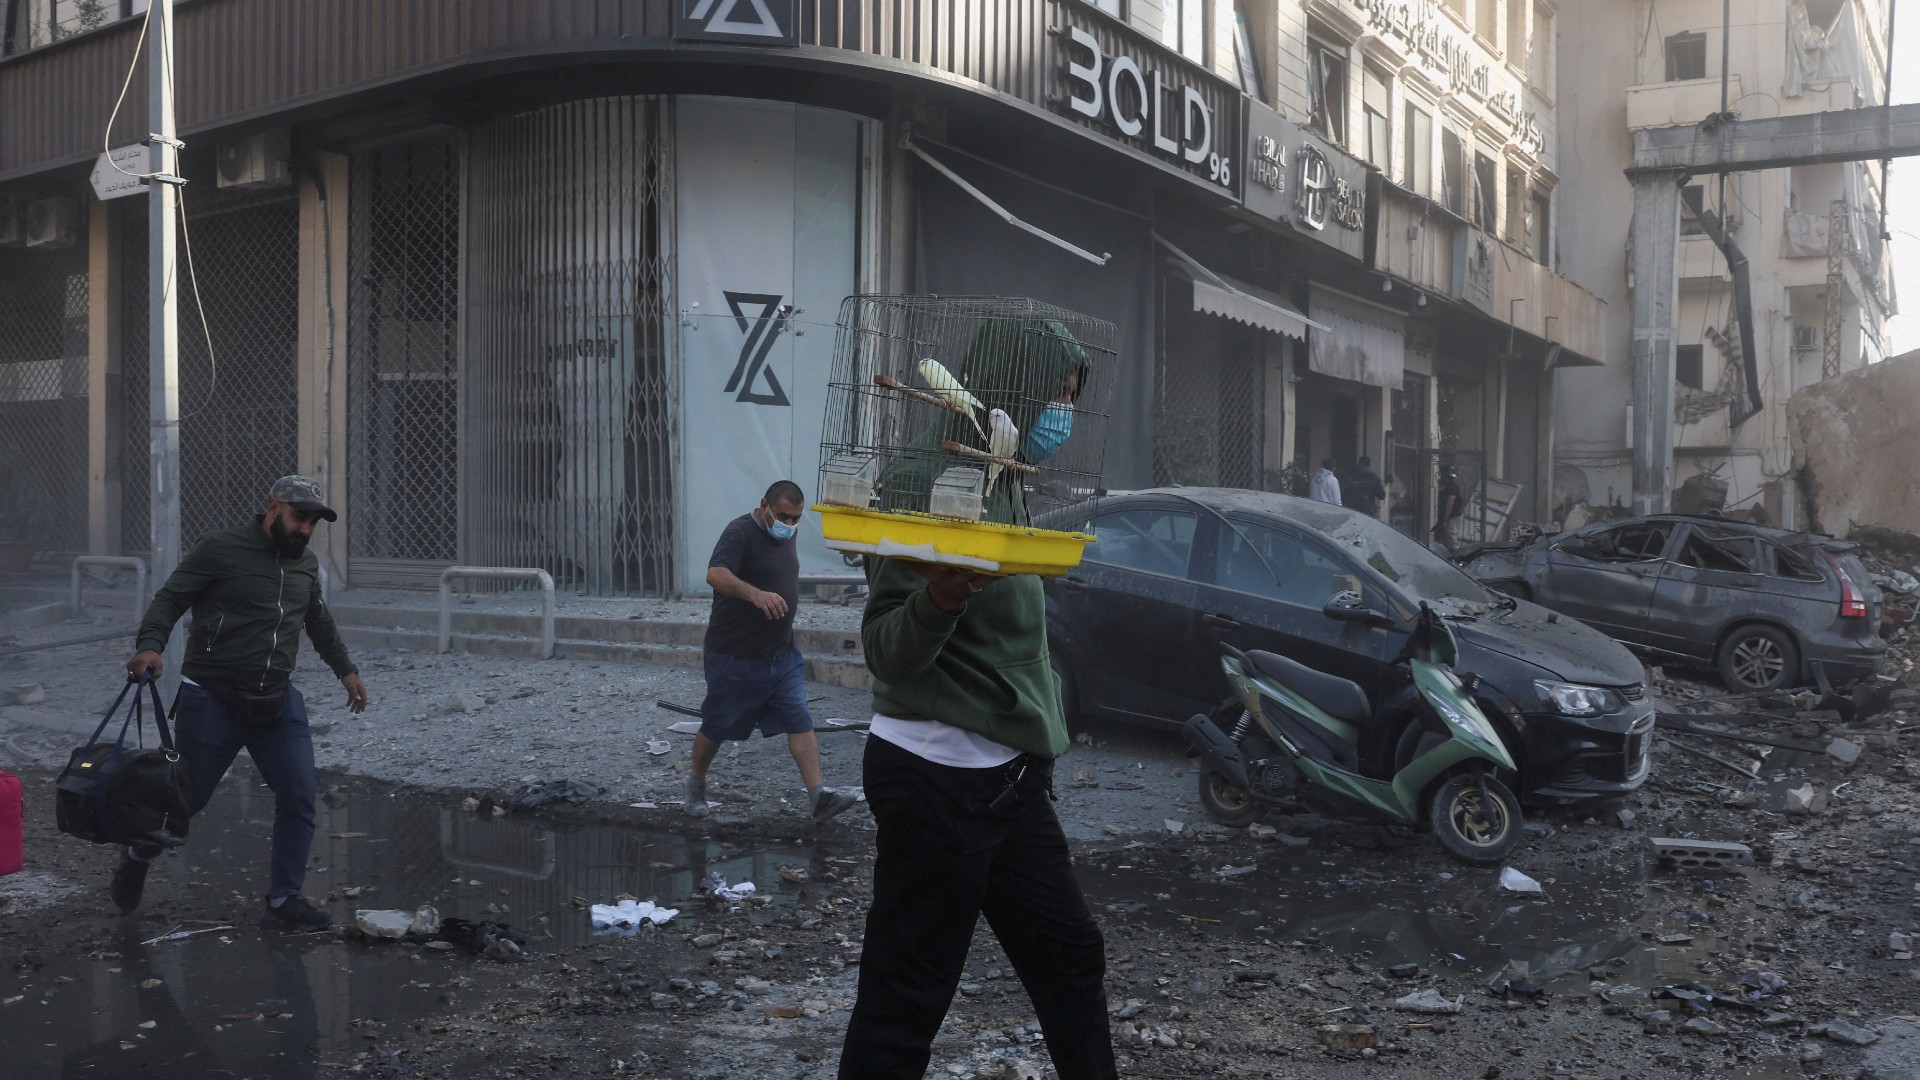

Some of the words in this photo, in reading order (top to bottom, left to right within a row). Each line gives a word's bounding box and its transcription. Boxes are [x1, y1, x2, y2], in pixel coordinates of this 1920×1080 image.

[1069, 25, 1211, 164] BOLD
[1209, 152, 1231, 186] 96
[1336, 177, 1366, 208] BEAUTY
[1337, 202, 1364, 231] SALON
